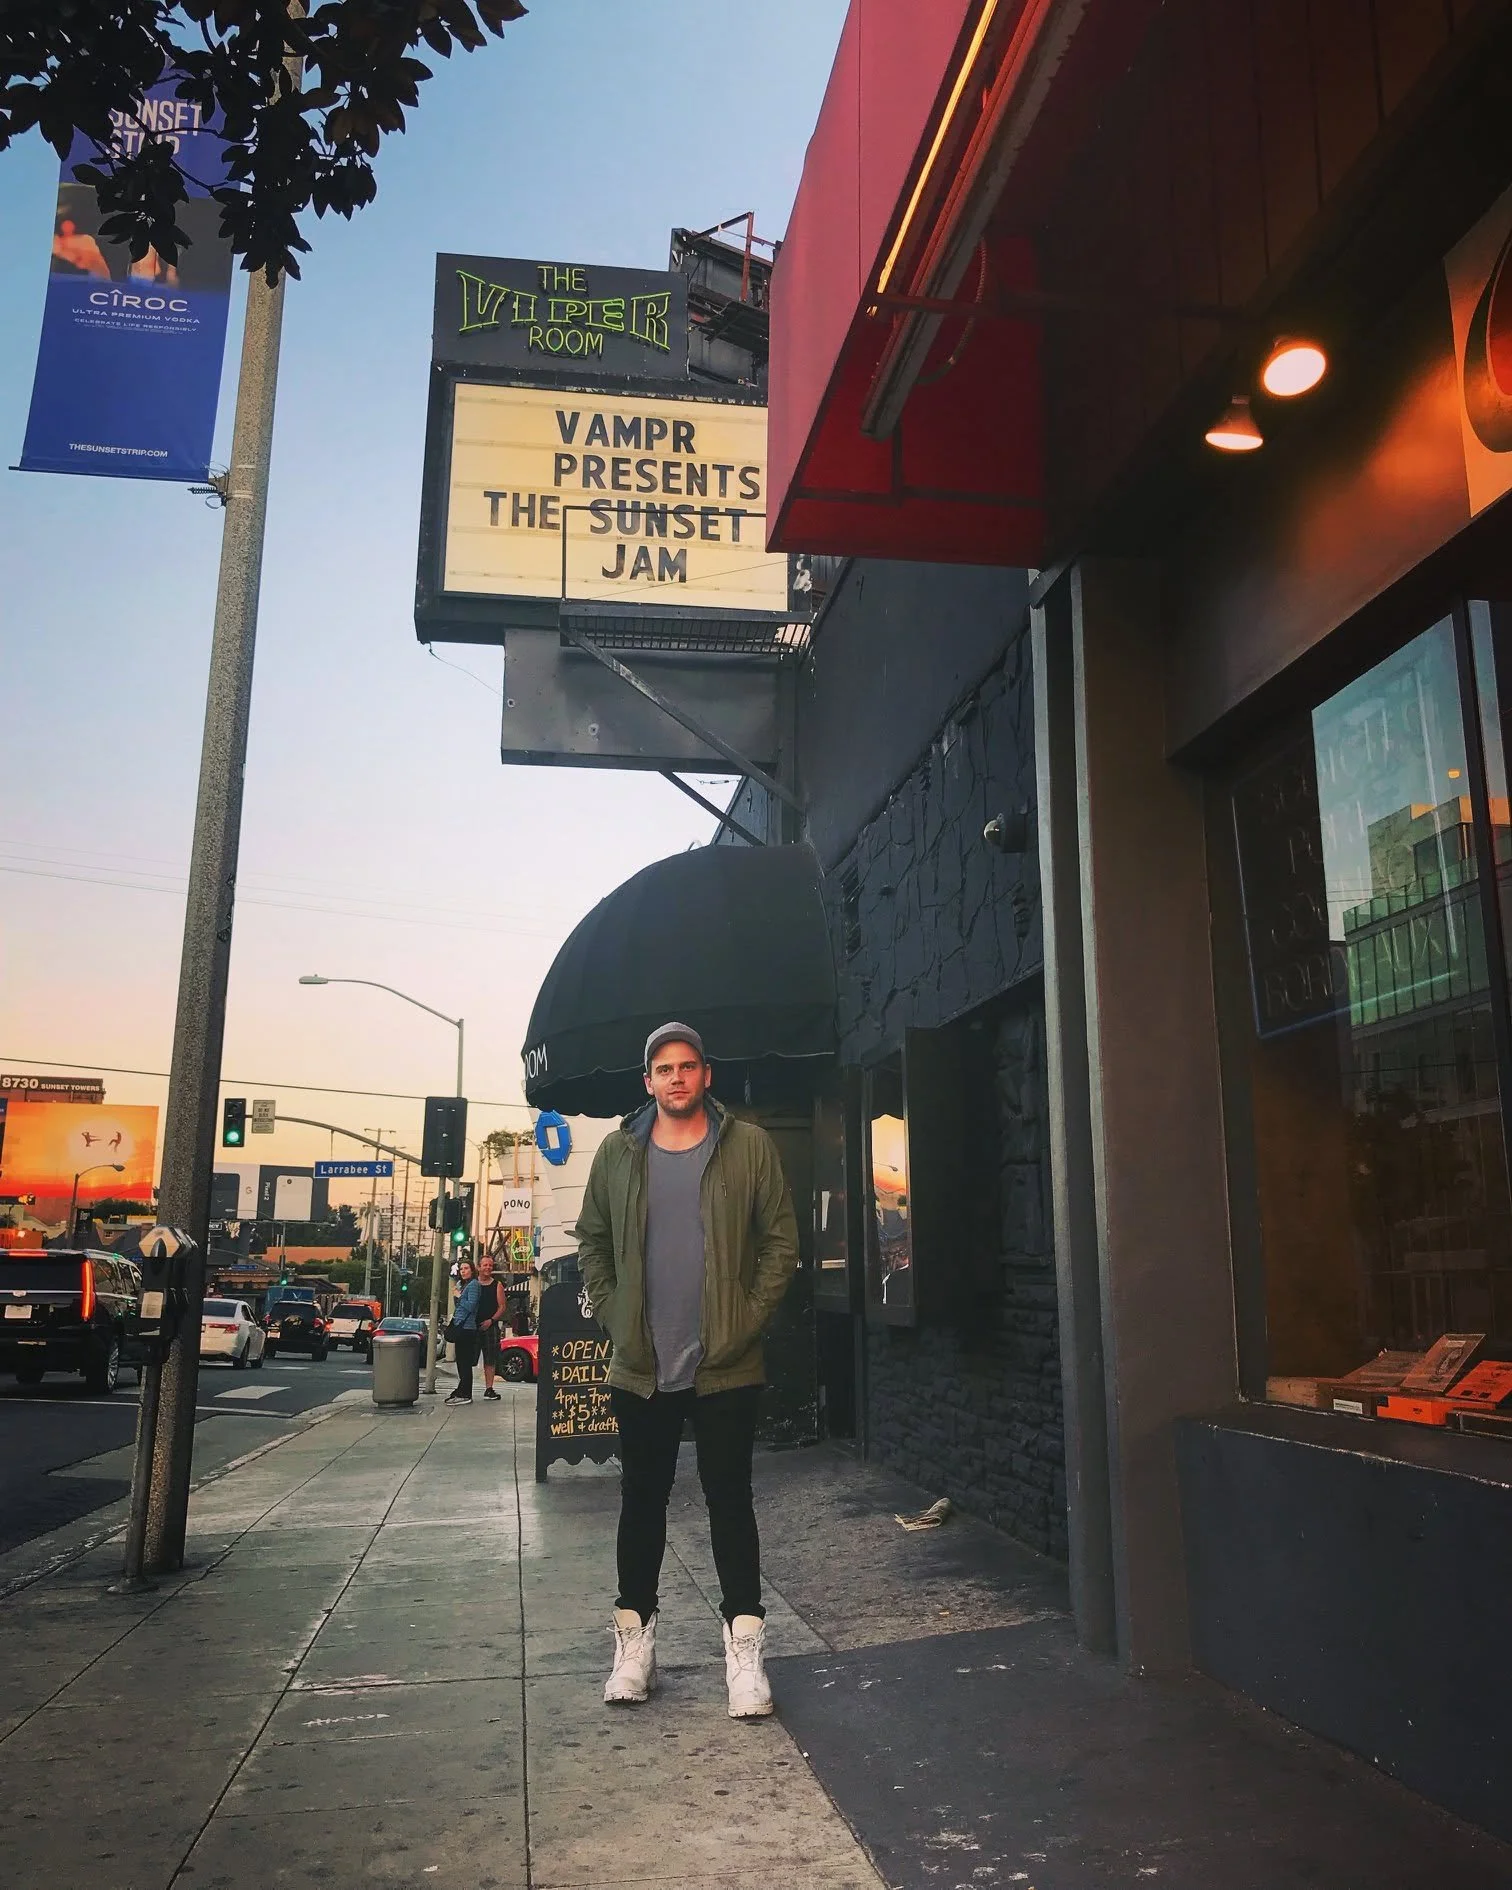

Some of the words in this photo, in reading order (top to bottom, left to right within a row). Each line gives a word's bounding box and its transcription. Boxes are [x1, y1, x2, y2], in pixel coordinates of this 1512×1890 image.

[537, 265, 586, 292] THE
[89, 288, 188, 312] CÎROC
[456, 270, 671, 351] VIPER
[72, 308, 108, 317] ULTRA
[111, 311, 161, 321] PREMIUM
[164, 316, 200, 324] VODKA
[528, 327, 604, 356] ROOM
[555, 410, 696, 454] VAMPR
[69, 443, 168, 458] THESUNSETSTRIP.COM
[553, 452, 760, 501] PRESENTS
[484, 490, 561, 530] THE
[589, 499, 747, 542] SUNSET
[601, 544, 687, 583] JAM
[2, 1077, 39, 1089] 8730
[71, 1084, 100, 1092] TOWERS
[320, 1165, 368, 1174] Larrabee
[375, 1164, 387, 1174] St
[503, 1199, 531, 1210] PONO
[562, 1339, 611, 1360] OPEN
[562, 1364, 611, 1383] DAILY
[550, 1419, 574, 1436] well
